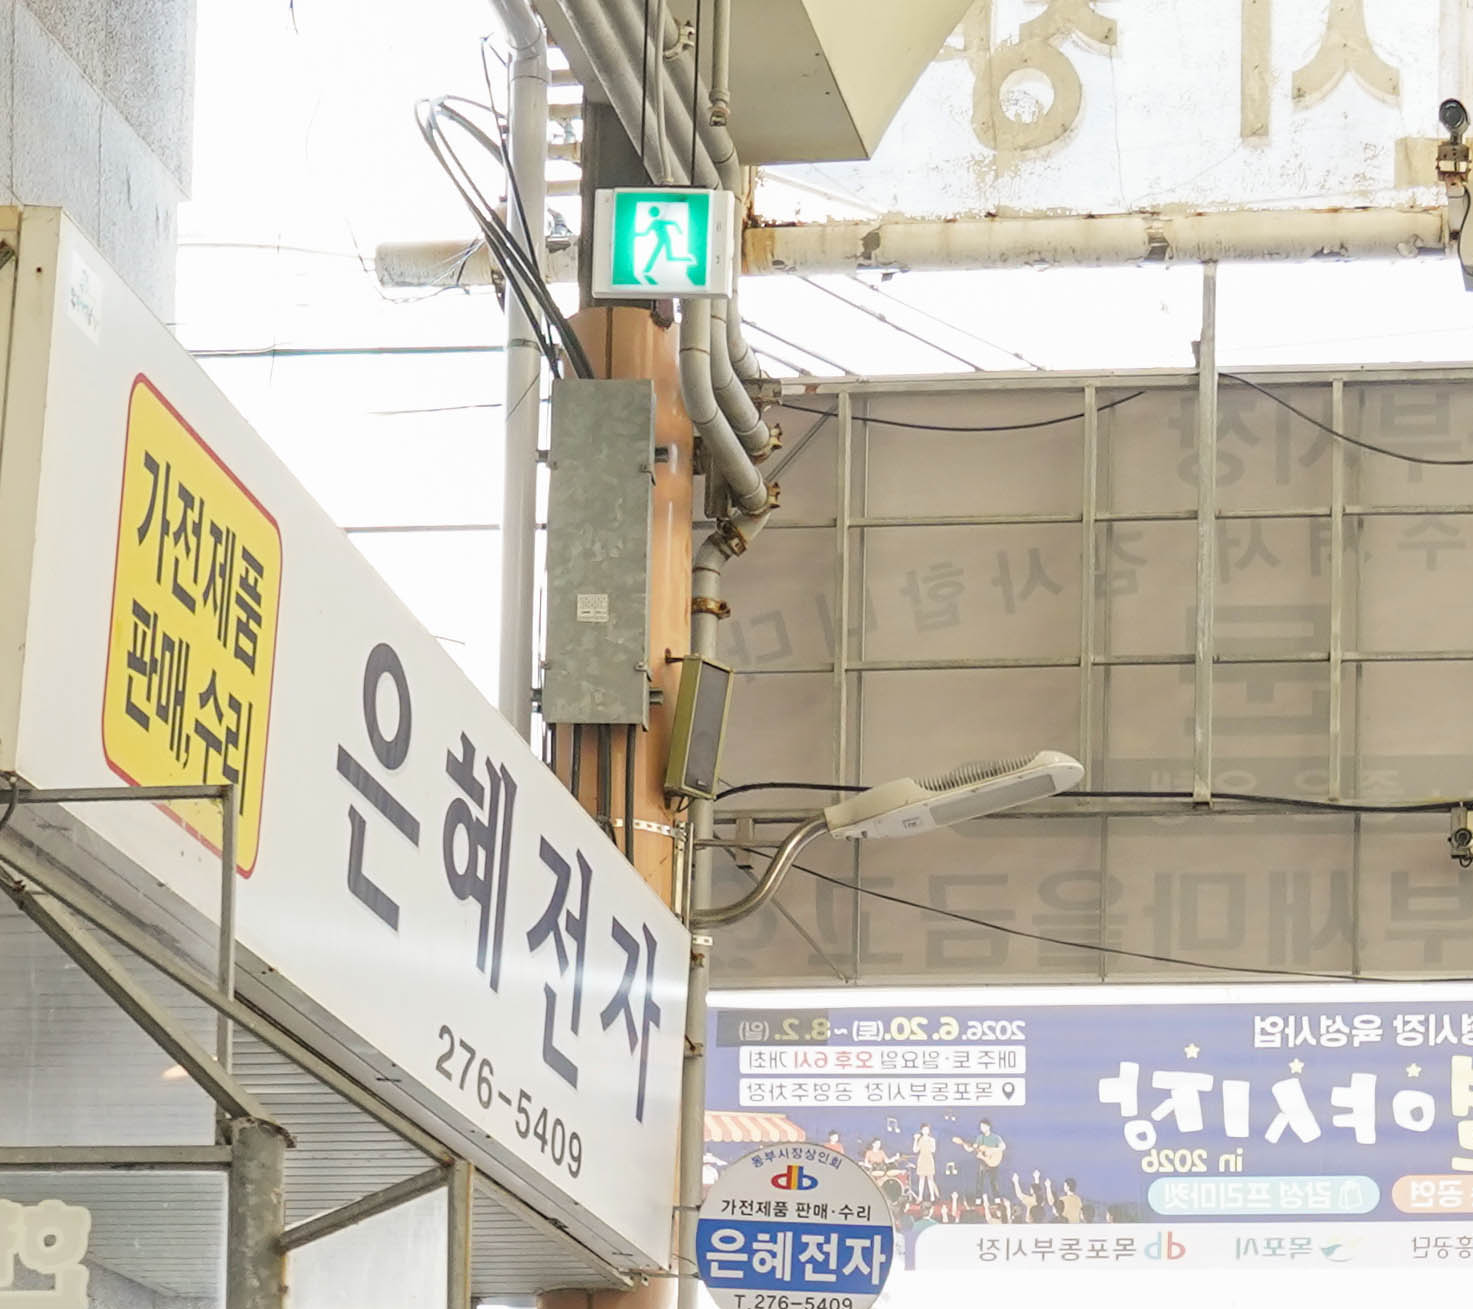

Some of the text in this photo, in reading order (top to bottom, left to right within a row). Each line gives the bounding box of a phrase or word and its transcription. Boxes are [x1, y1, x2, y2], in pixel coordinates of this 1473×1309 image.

[136, 452, 265, 676] 가전제품
[124, 596, 254, 815] 판매,수리
[337, 642, 662, 1124] 은혜전자
[437, 1024, 583, 1178] 276-5409
[751, 1149, 843, 1170] 동부시장상인회
[706, 1228, 886, 1286] 은혜전자
[720, 1199, 872, 1221] 가전제품 판매·수리
